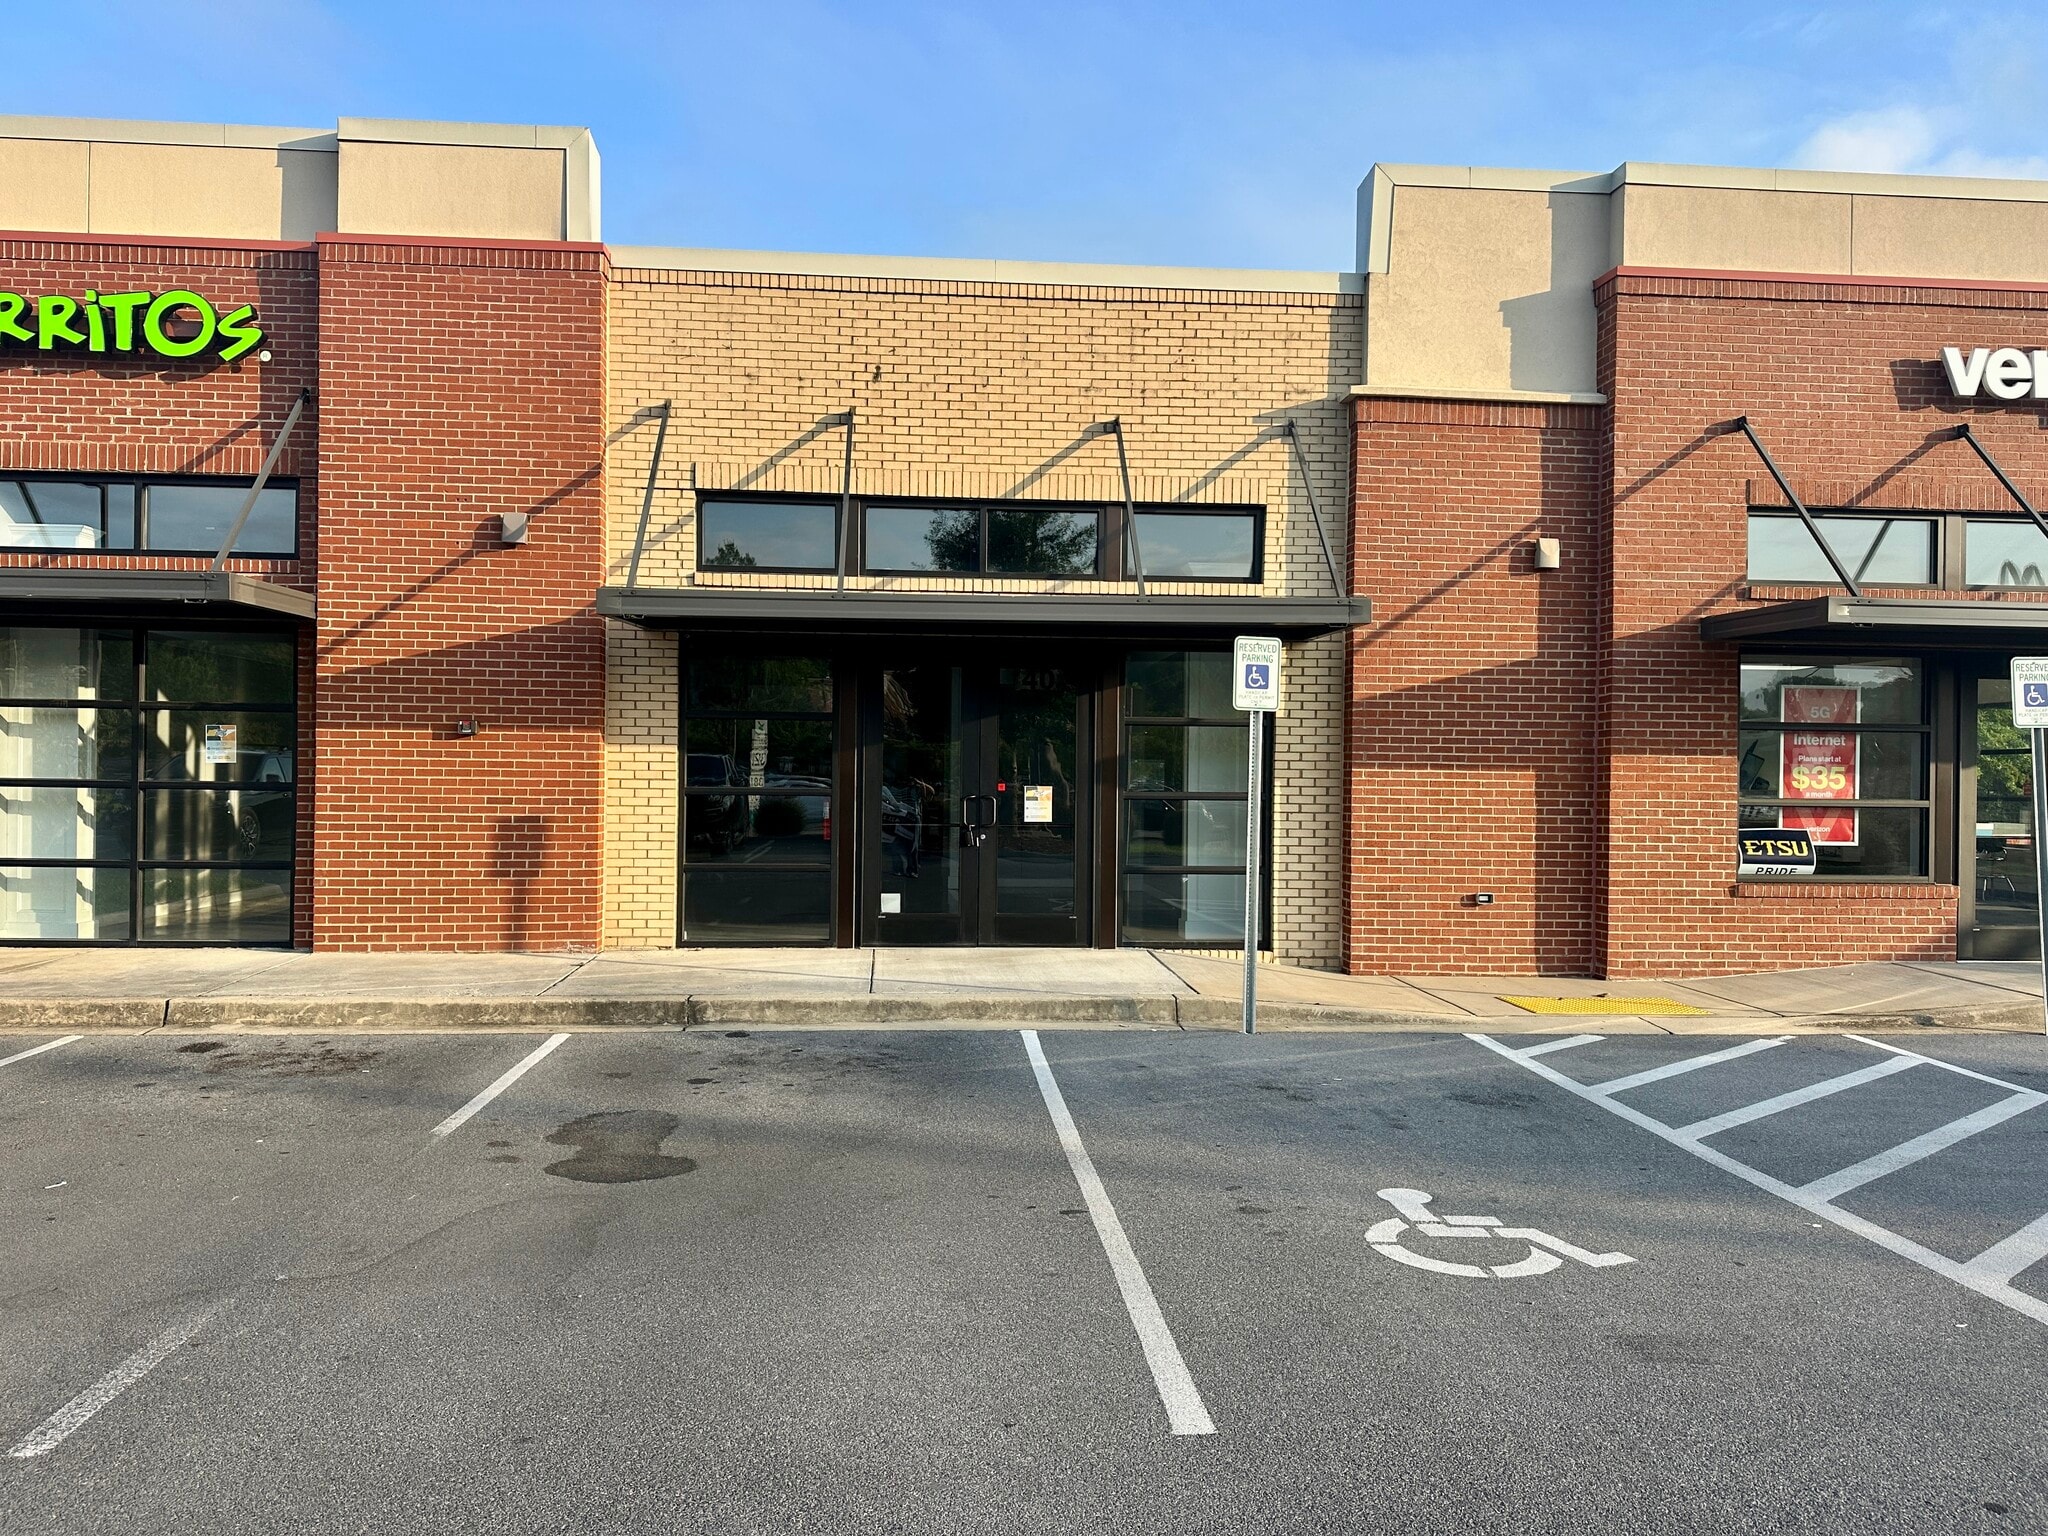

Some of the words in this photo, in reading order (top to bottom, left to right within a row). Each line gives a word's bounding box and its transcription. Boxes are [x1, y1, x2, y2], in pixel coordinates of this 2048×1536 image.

[1239, 643, 1277, 653] RESERVED
[1241, 653, 1273, 663] PARKING
[1810, 706, 1830, 718] 5G
[1793, 733, 1846, 746] Internet
[1791, 765, 1846, 791] $35
[1743, 840, 1809, 857] ETSU
[1755, 867, 1798, 875] PRIDE
